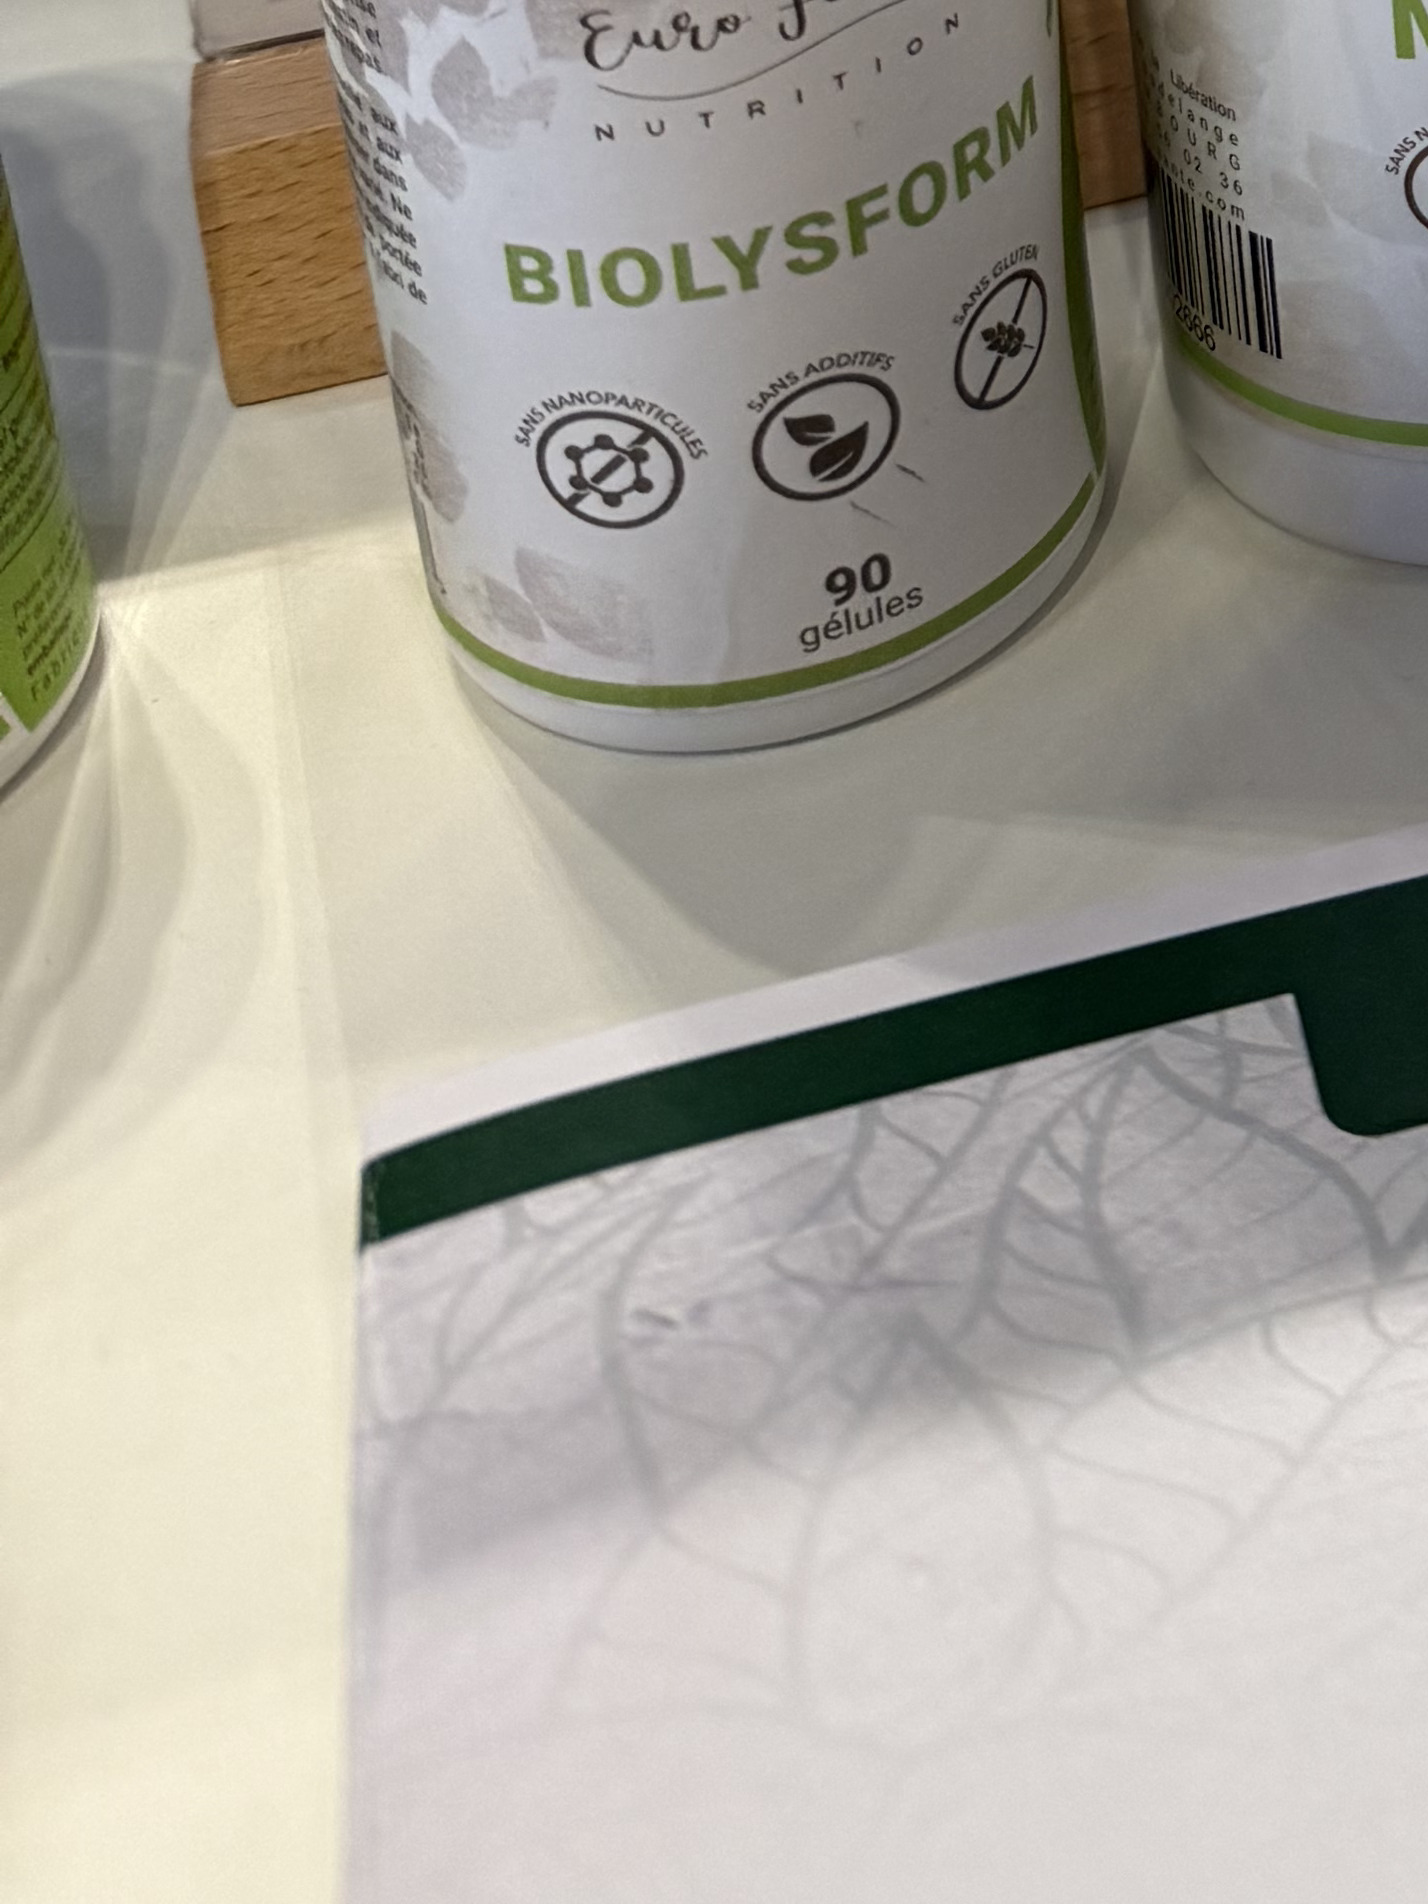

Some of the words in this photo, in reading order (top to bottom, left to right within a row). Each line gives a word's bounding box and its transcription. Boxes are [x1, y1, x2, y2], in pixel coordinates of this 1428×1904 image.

[578, 10, 742, 71] Euro
[594, 13, 963, 142] NUTRITION
[503, 73, 1041, 312] BIOLYSFORM
[1384, 138, 1418, 176] SANS
[952, 277, 990, 327] SANS
[991, 243, 1039, 279] GLUTEN
[746, 370, 800, 413] SANS
[803, 351, 894, 383] ADDITIFS
[514, 403, 548, 448] SANS
[537, 391, 707, 465] NANOPARTICULES
[825, 553, 894, 608] 90
[798, 582, 926, 657] gélules
